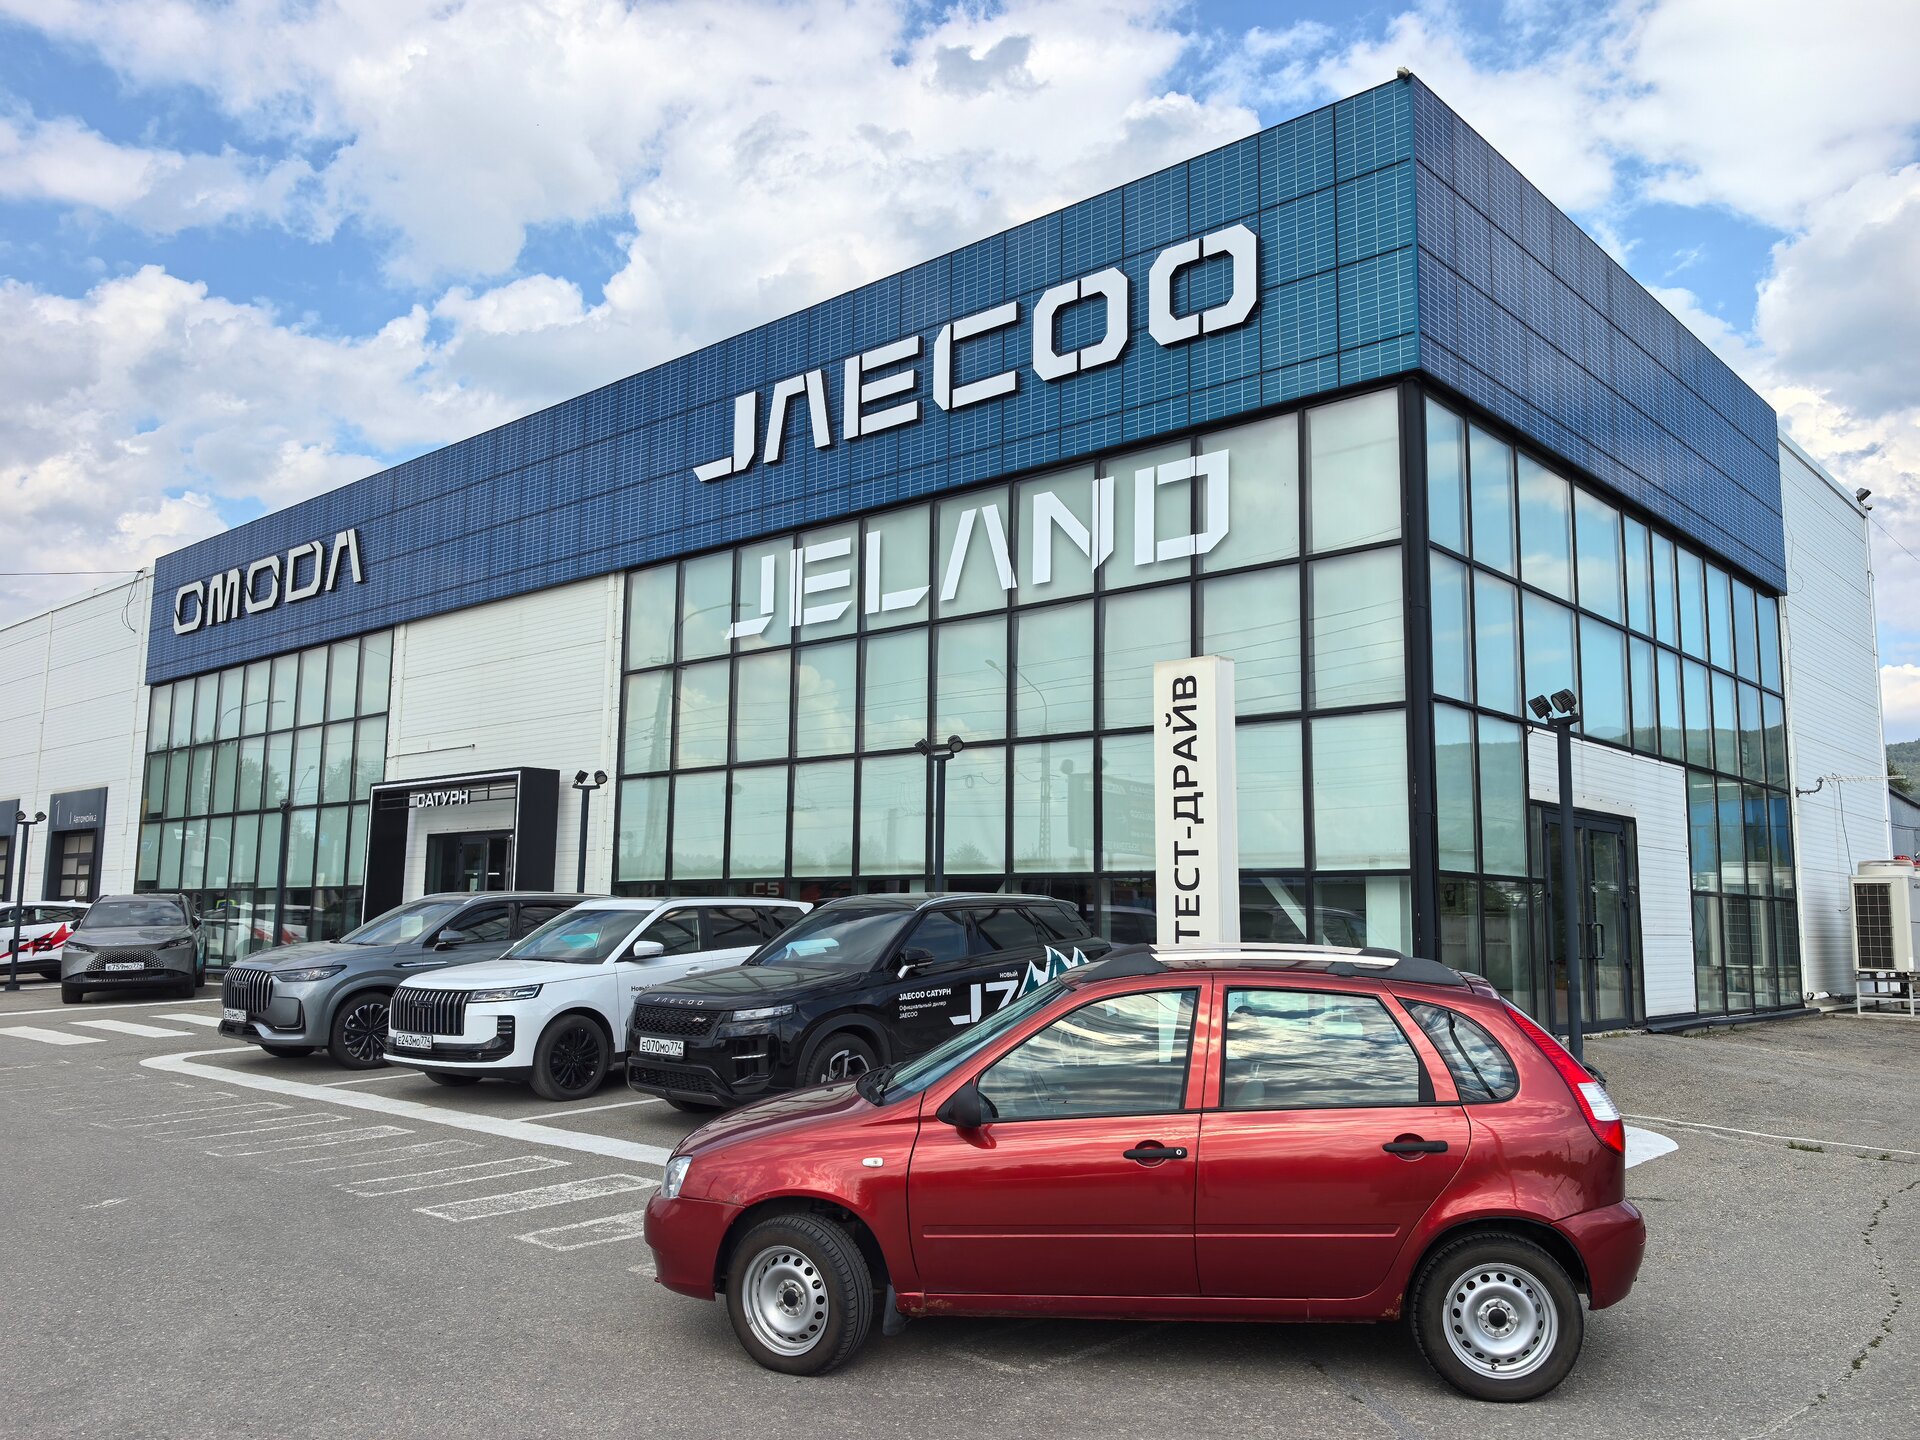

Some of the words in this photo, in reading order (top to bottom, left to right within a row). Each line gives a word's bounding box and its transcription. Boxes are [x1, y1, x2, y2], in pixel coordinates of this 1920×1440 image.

[693, 223, 1258, 482] JAECOO
[725, 448, 1229, 640] JELAND
[173, 528, 363, 635] OMODA
[416, 789, 469, 808] САТУРН
[1165, 674, 1204, 944] ТЕСТ-ДРАЙВ
[654, 997, 704, 1006] JAECOO
[898, 991, 925, 1001] JAECOO
[926, 988, 952, 998] САТУРН
[899, 1001, 932, 1011] Официальный
[949, 979, 1019, 1026] J7
[899, 1011, 919, 1019] JAECOO
